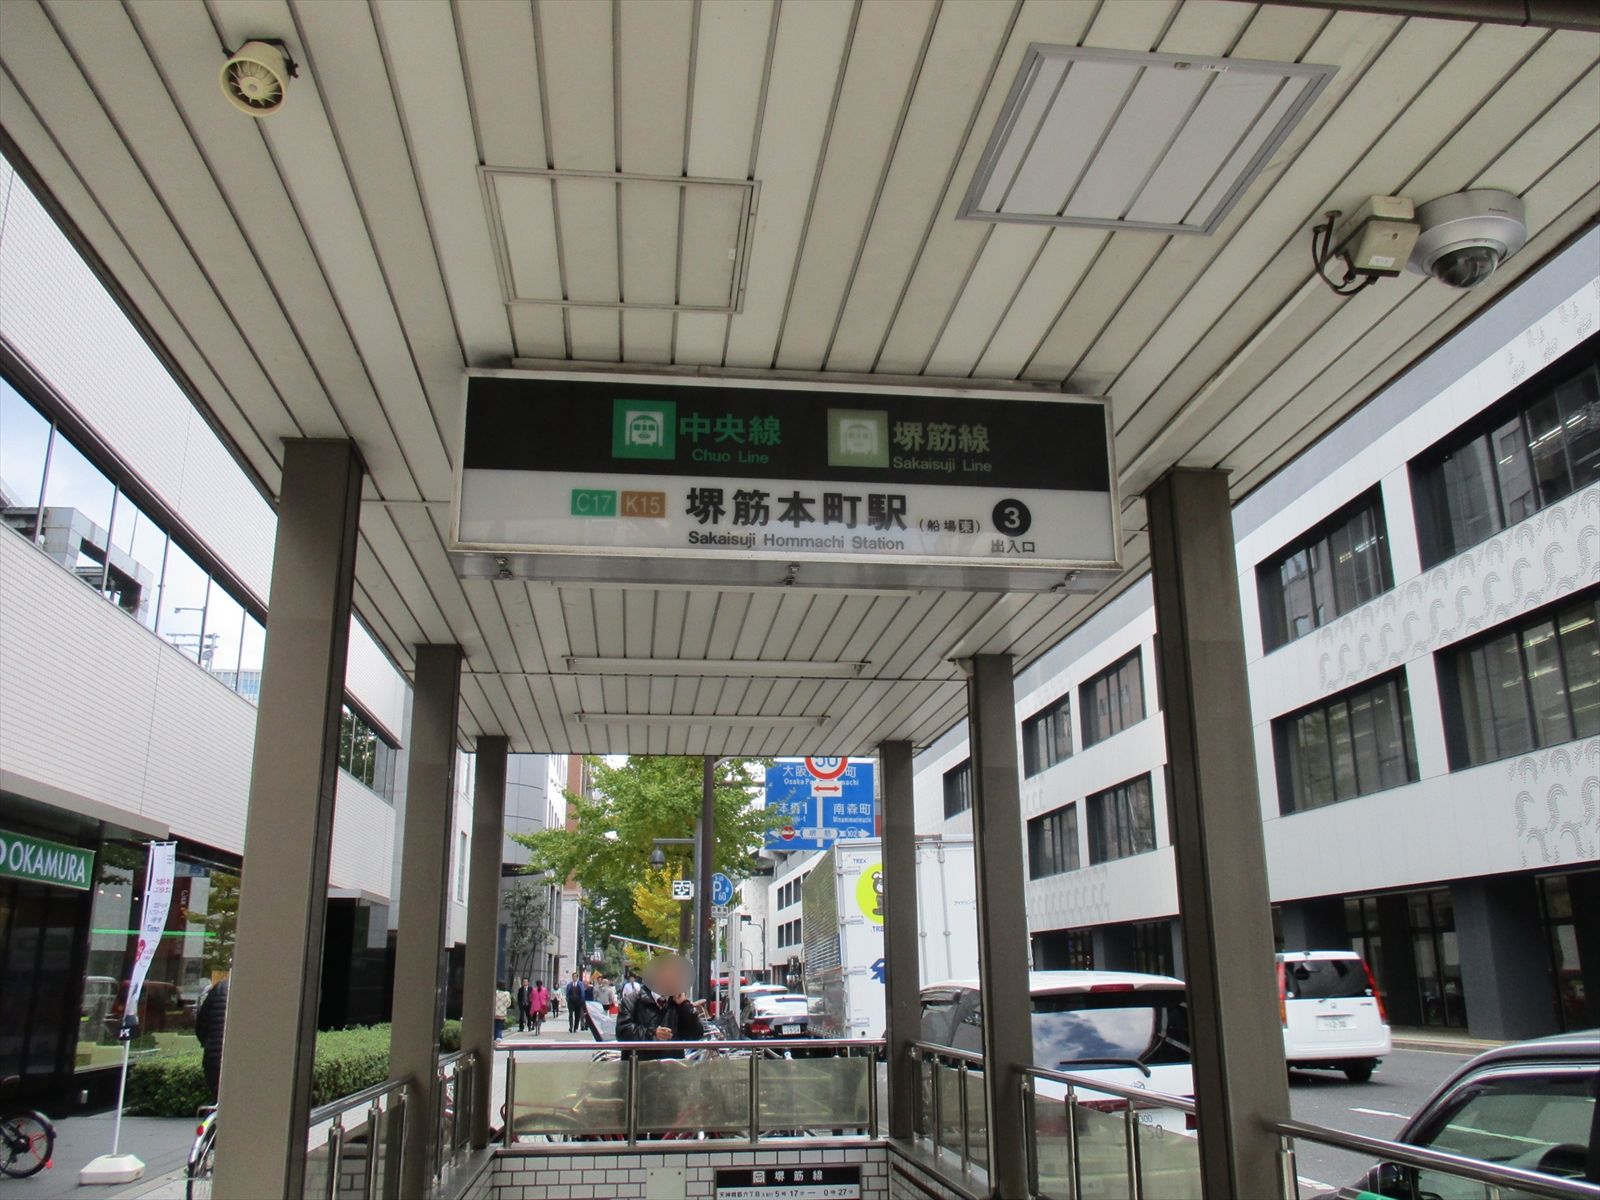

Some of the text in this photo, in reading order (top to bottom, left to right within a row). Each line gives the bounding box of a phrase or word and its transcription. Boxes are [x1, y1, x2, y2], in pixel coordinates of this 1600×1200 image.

[679, 413, 782, 446] 中央線
[893, 421, 991, 453] 堺筋線
[692, 448, 769, 464] Chuo Line
[893, 456, 992, 473] Sakaisuji Line
[576, 493, 611, 511] C17
[625, 496, 661, 515] K15
[685, 488, 907, 531] 堺筋本町駅
[1003, 506, 1020, 529] 3
[688, 531, 905, 551] Sakaisuji Hommachi Station
[991, 540, 1036, 553] 出入口
[833, 803, 871, 815] 南森町
[9, 841, 85, 883] OKAMURA
[774, 1168, 824, 1182] 堺筋線
